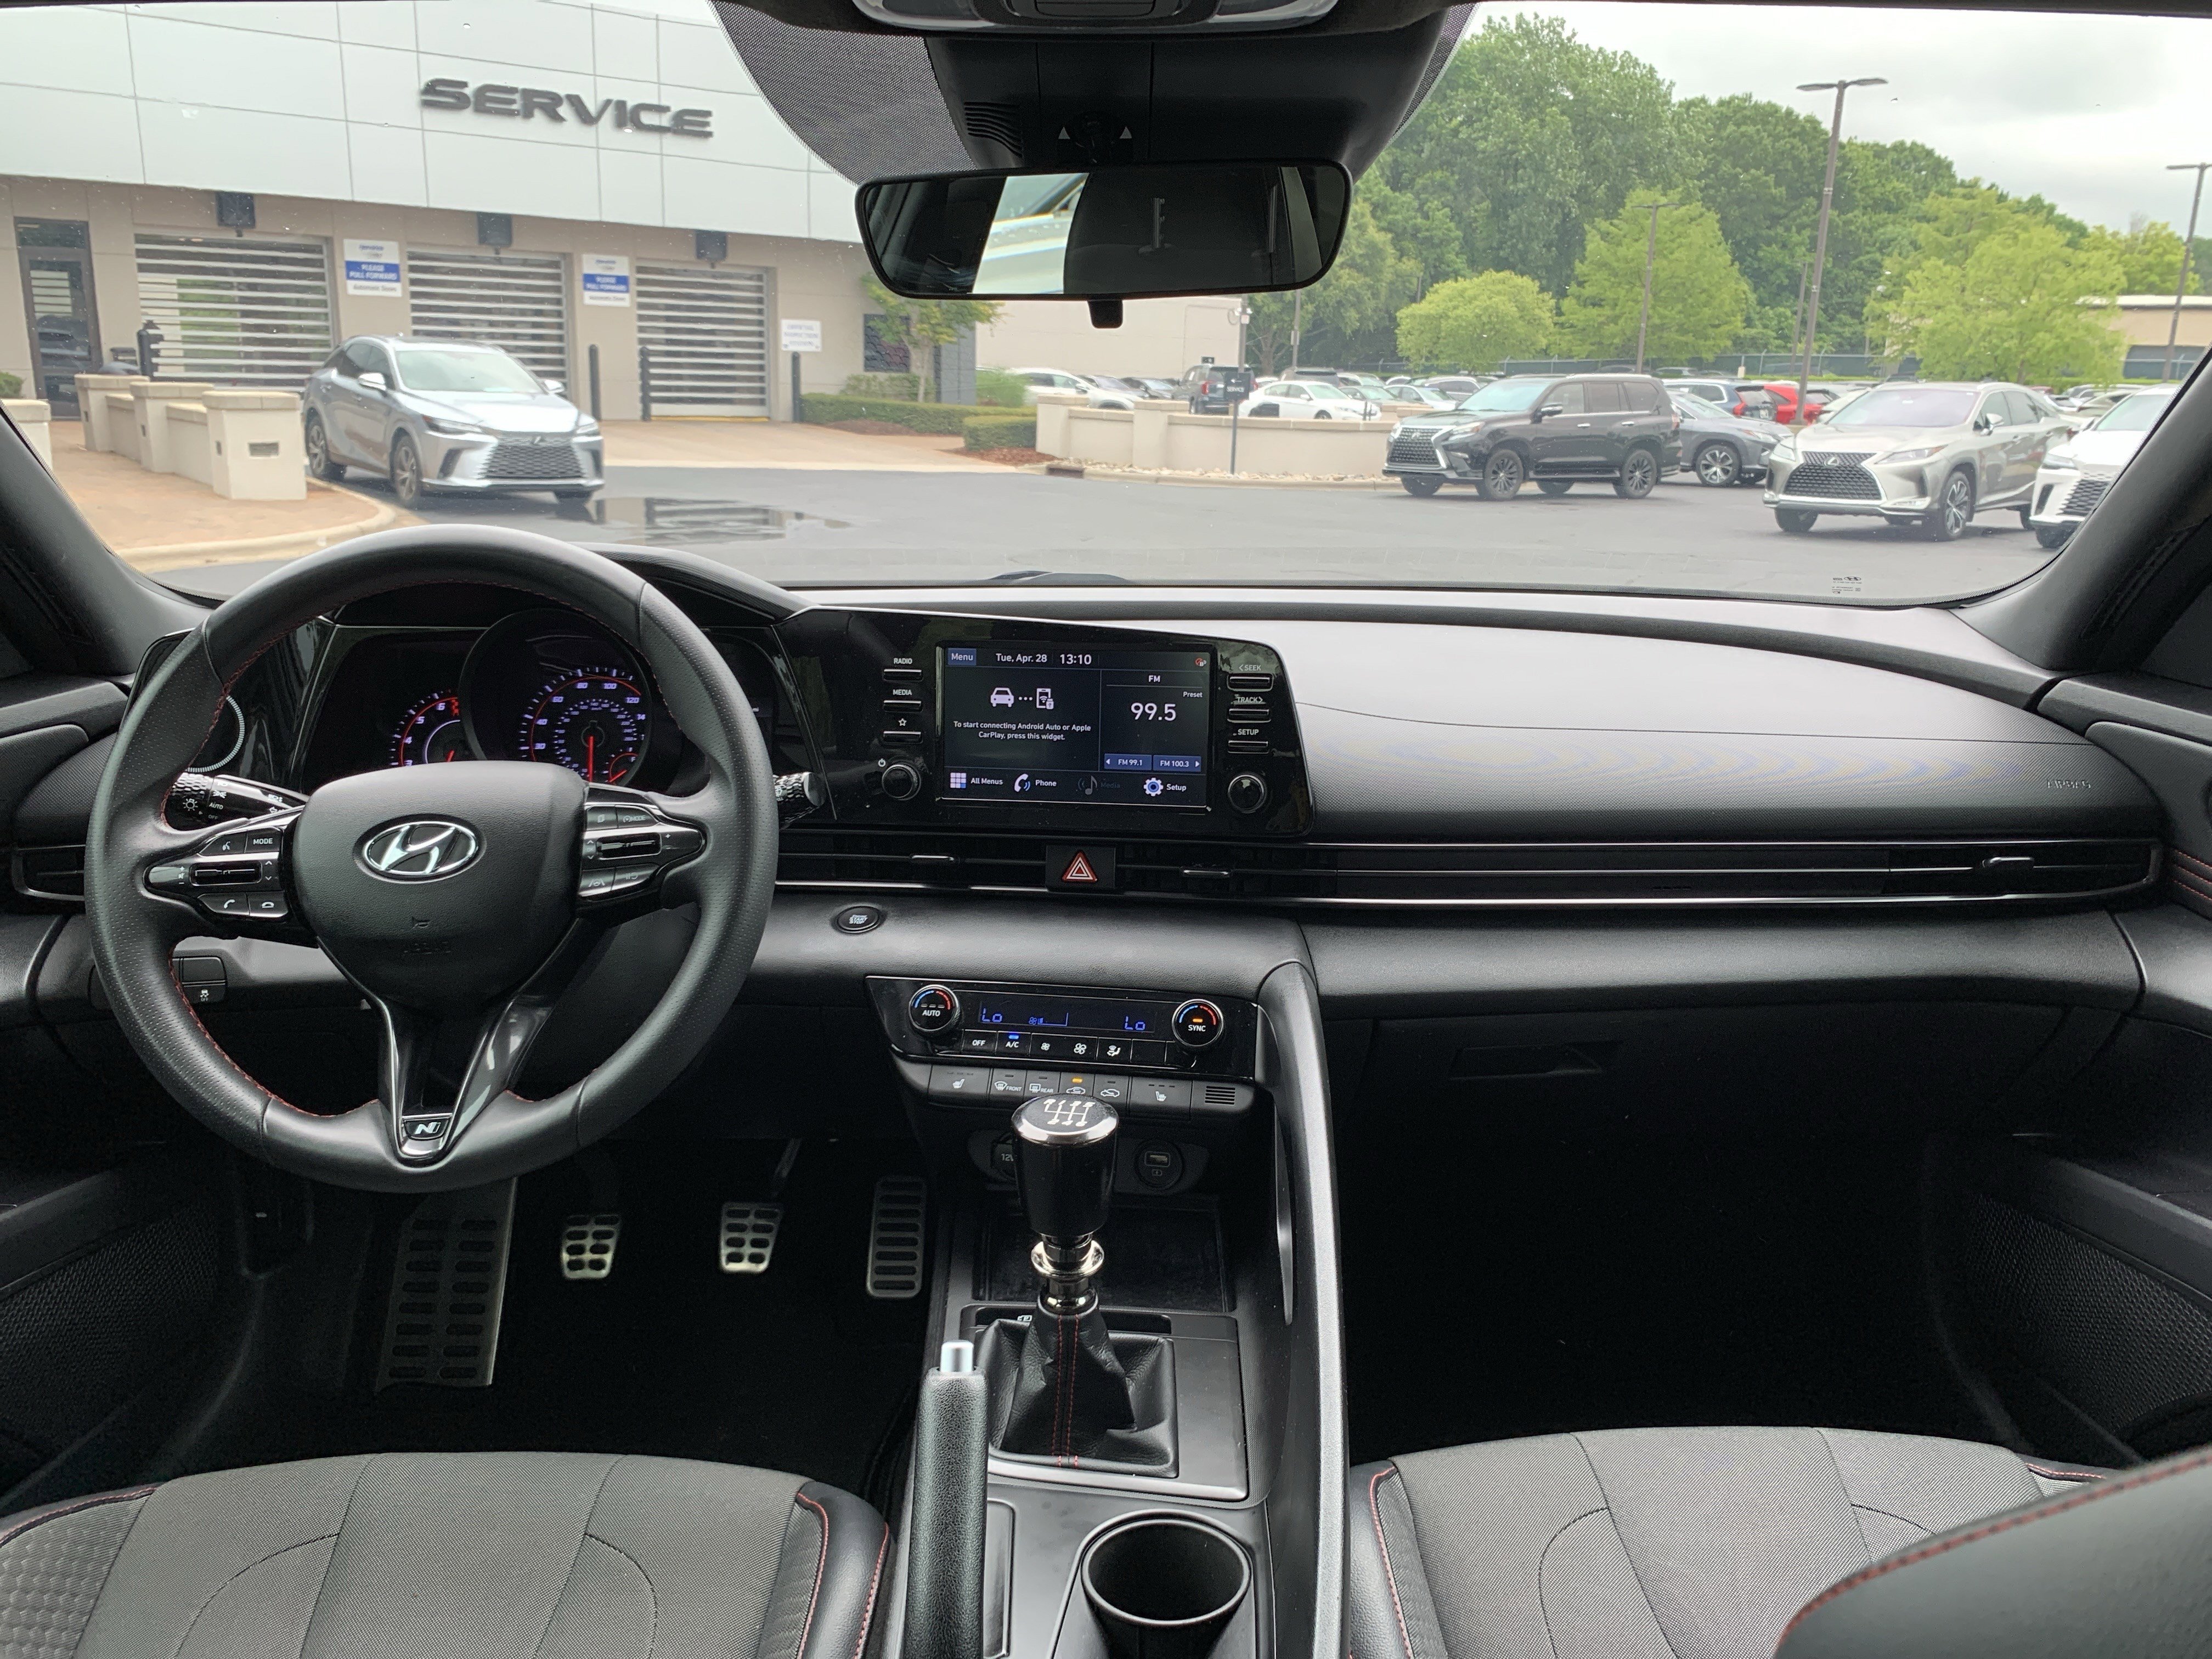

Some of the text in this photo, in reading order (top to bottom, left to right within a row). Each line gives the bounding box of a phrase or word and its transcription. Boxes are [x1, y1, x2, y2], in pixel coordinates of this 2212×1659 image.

[420, 77, 713, 138] SERVICE
[951, 653, 973, 661] Menu
[996, 653, 1014, 663] Tue,
[1016, 654, 1034, 664] Apr.
[1060, 654, 1092, 665] 13:10
[1131, 702, 1176, 721] 99.5
[416, 716, 425, 724] 5
[980, 722, 1016, 731] connecting
[1071, 724, 1091, 732] Apple
[979, 731, 1006, 740] CarPlay,
[1041, 733, 1065, 742] widget.
[1166, 783, 1186, 792] Setup
